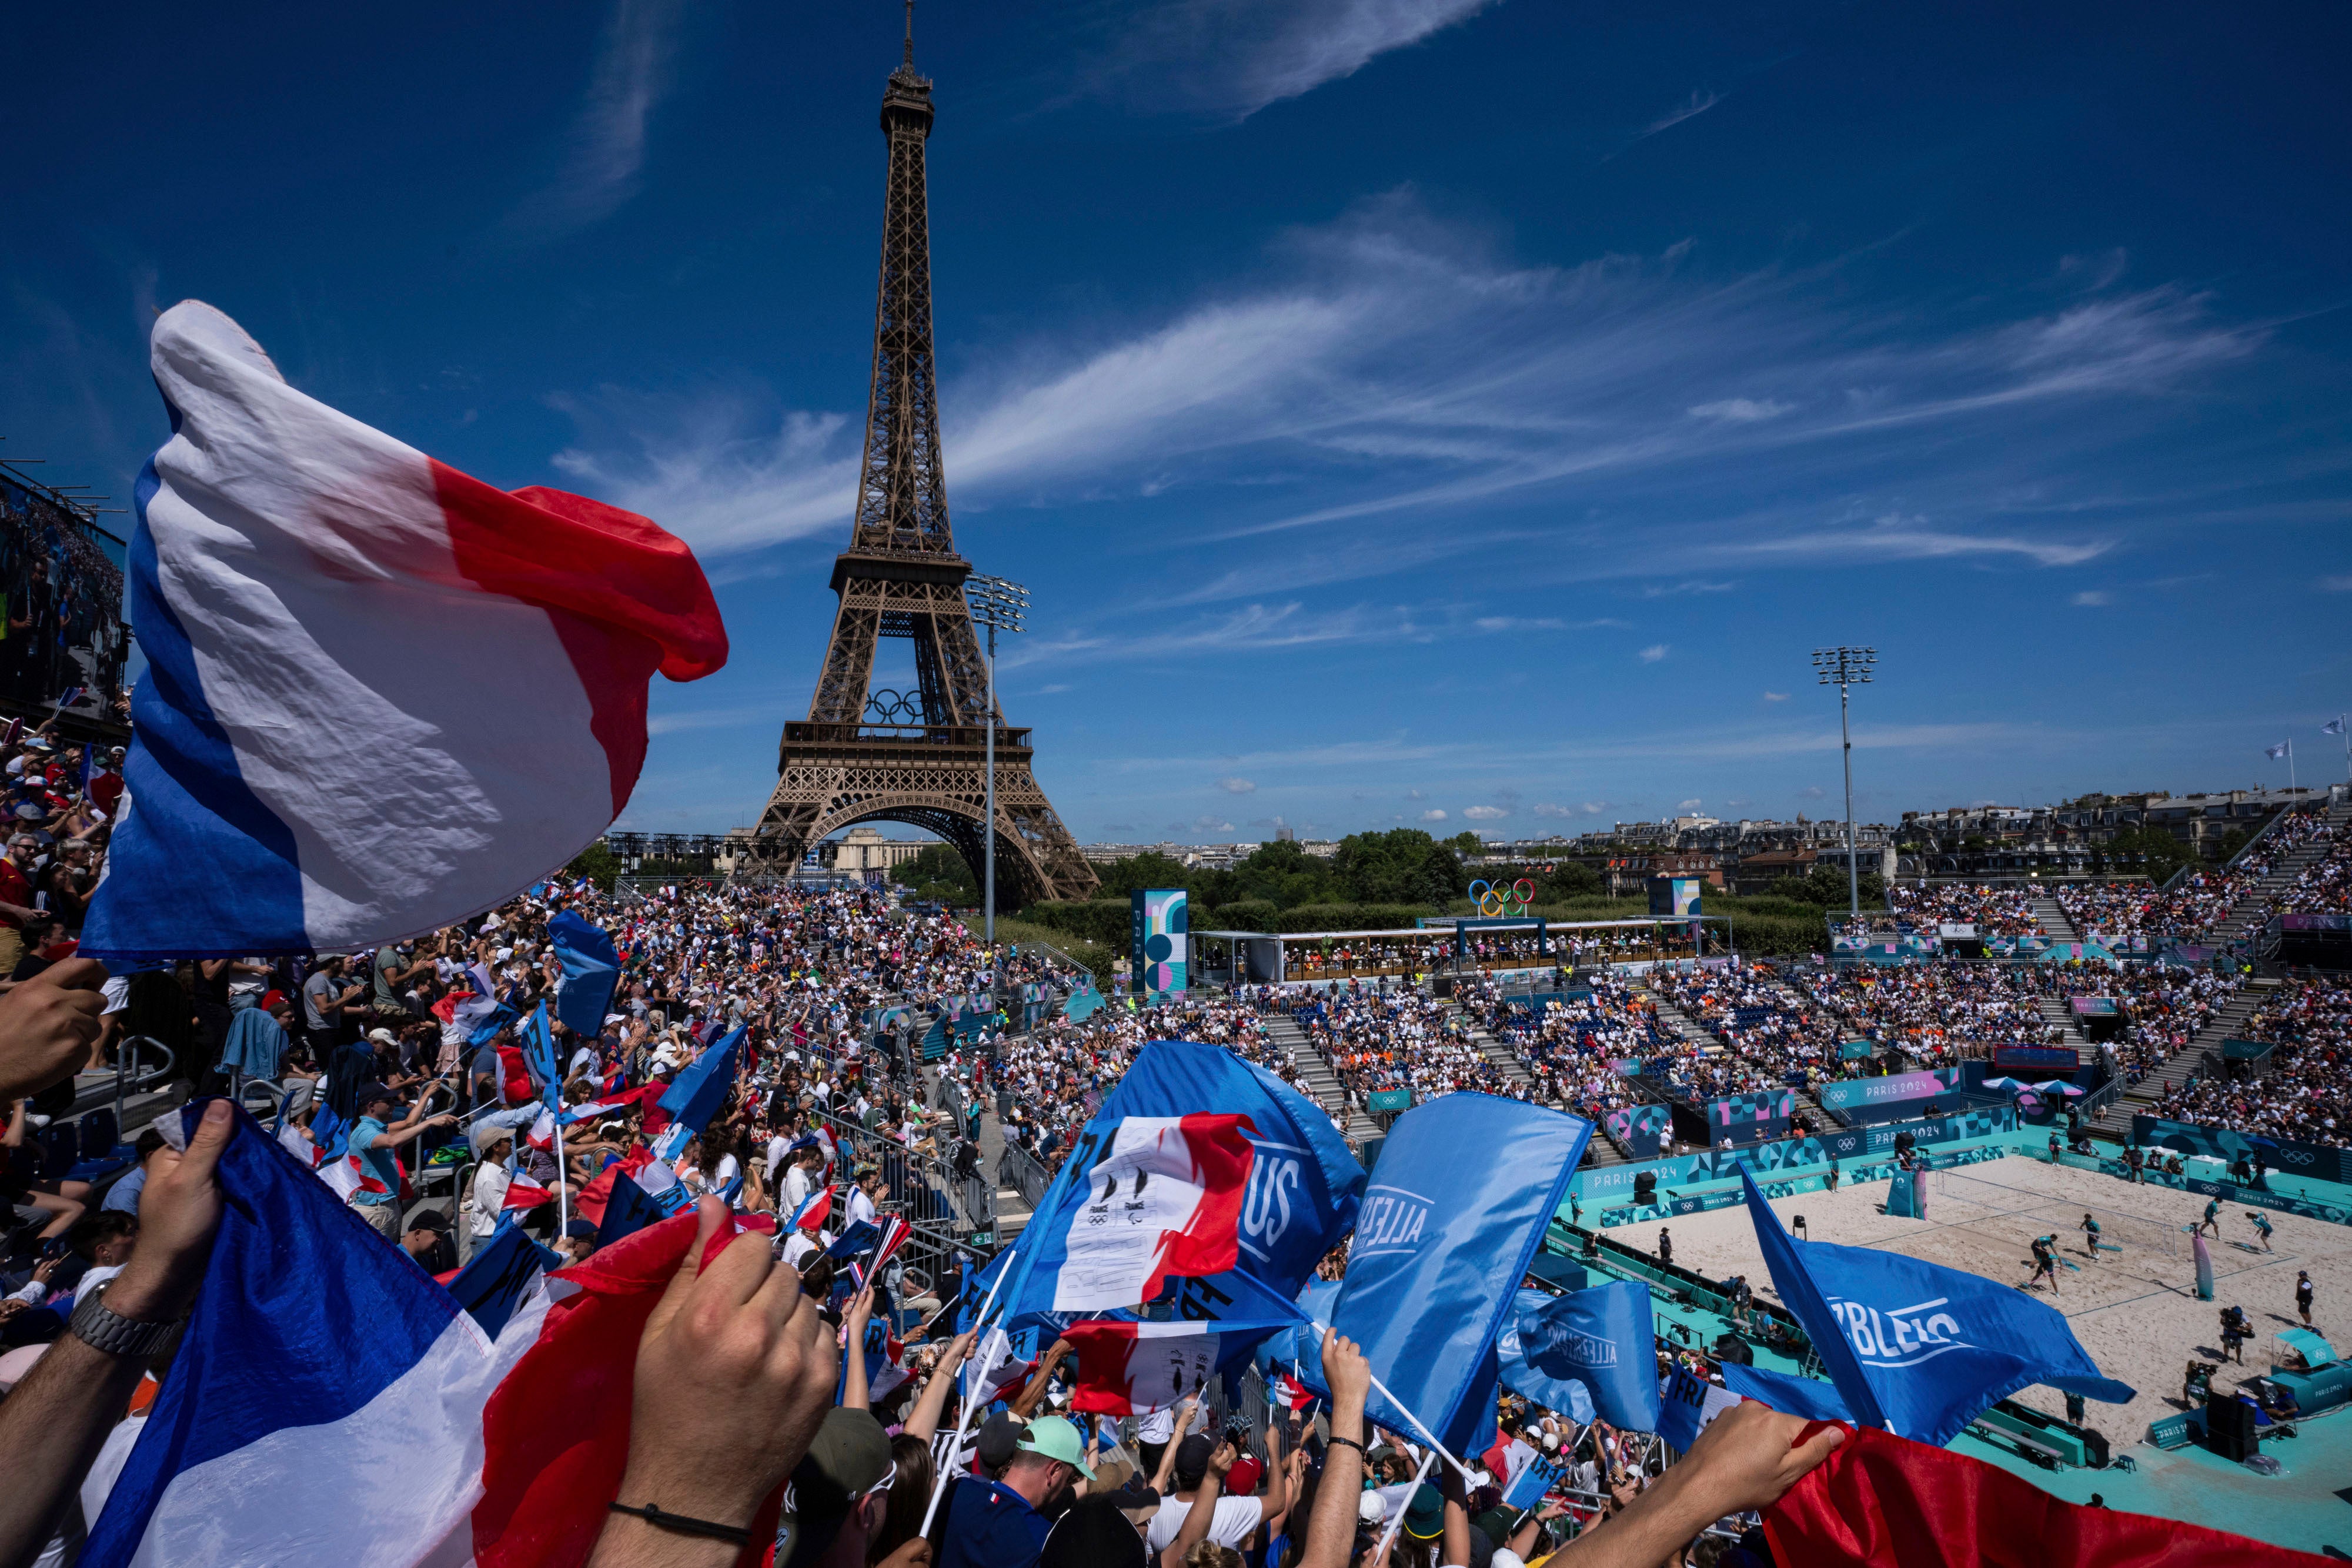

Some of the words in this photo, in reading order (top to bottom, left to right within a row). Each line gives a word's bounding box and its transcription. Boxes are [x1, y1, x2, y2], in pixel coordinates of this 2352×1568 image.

[1866, 1084, 1896, 1098] PARIS
[1900, 1081, 1927, 1094] 2024
[1911, 1125, 1940, 1139] 2024
[1594, 1172, 1635, 1188] PARIS
[1639, 1166, 1676, 1179] 024
[2239, 1193, 2261, 1202] PARIS
[2263, 1197, 2284, 1206] 2024
[2315, 1389, 2330, 1398] PARIS
[2330, 1384, 2343, 1395] 2024
[2159, 1426, 2180, 1439] PARIS
